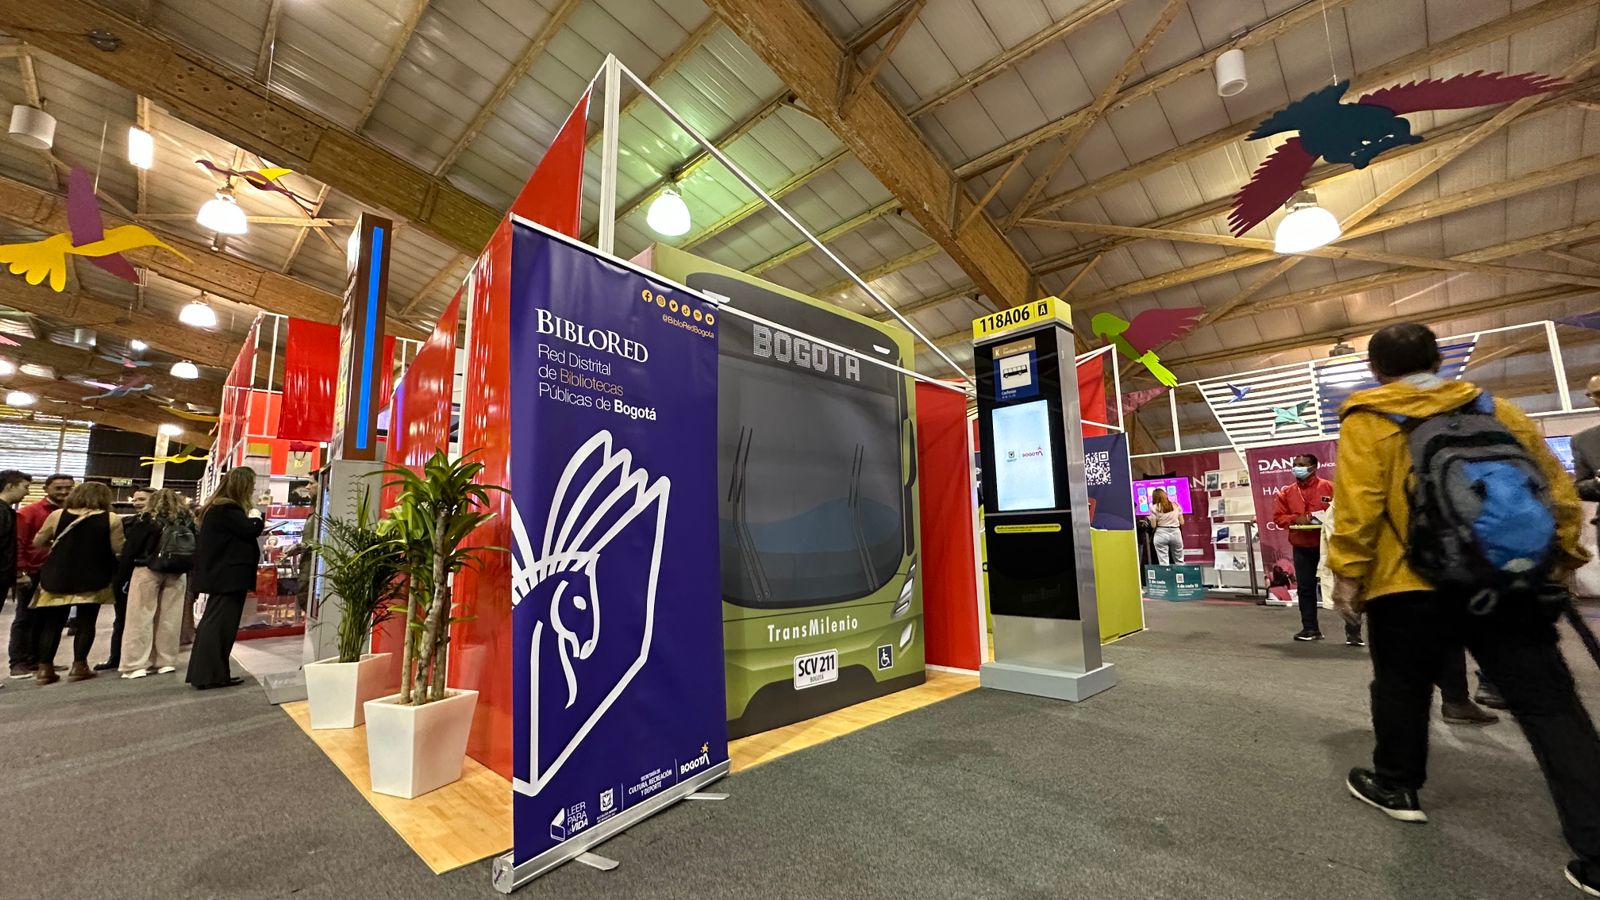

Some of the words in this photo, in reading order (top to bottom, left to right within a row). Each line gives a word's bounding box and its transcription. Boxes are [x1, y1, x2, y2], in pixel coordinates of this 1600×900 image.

[980, 306, 1030, 332] 118A06
[538, 344, 566, 364] Red
[569, 352, 611, 376] Distrital
[538, 364, 557, 380] de
[560, 367, 624, 397] Bibliotecas
[539, 381, 593, 408] Públicas
[595, 396, 612, 411] de
[614, 399, 657, 420] Bogotá
[1258, 456, 1297, 471] DAN
[767, 615, 859, 642] TransMilenio
[798, 657, 818, 677] SCV
[820, 654, 834, 672] 211
[628, 780, 648, 795] CULTURA,
[644, 781, 662, 795] DEPORTE
[567, 801, 586, 817] LEER
[567, 811, 587, 826] PARA
[571, 817, 589, 833] VIDA
